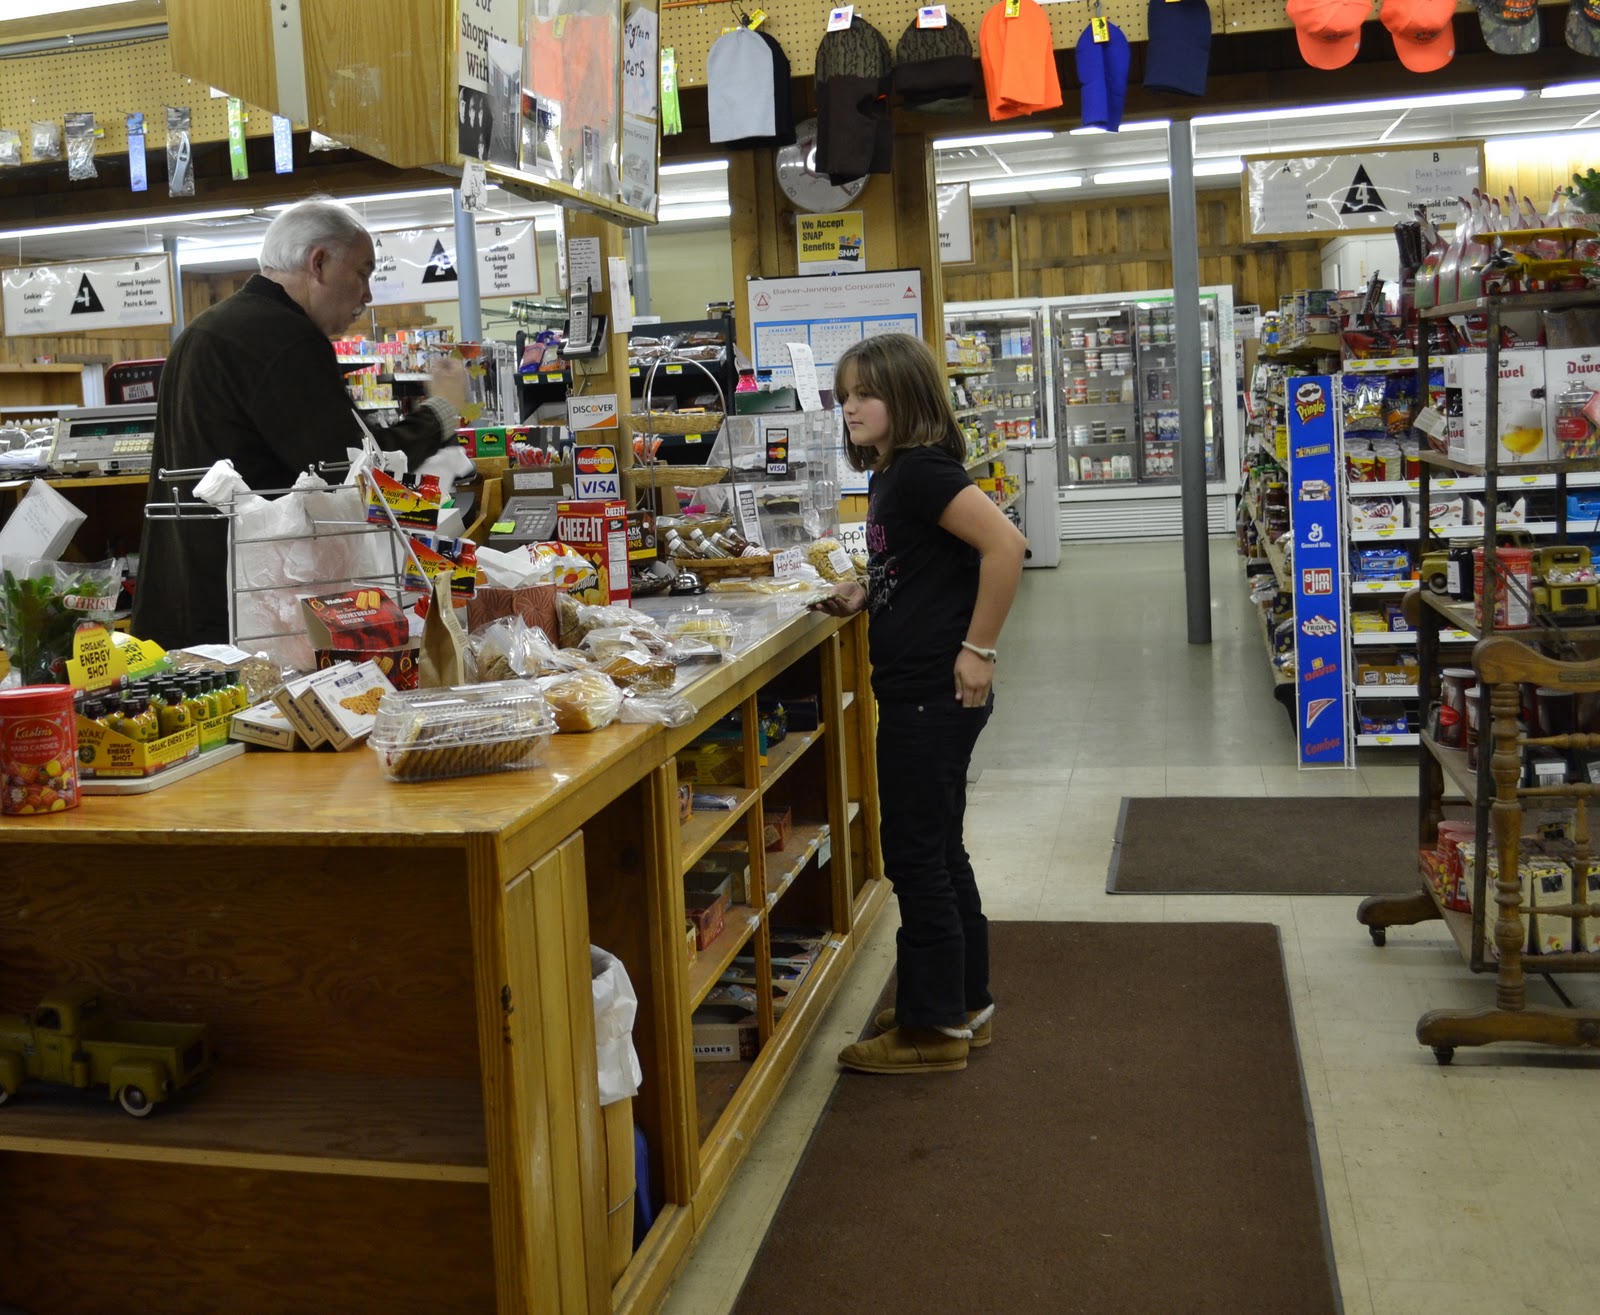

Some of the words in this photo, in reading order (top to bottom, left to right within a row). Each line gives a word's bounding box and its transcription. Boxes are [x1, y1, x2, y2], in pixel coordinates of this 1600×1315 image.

[462, 11, 507, 52] Shoppi
[624, 23, 650, 48] ergreen
[466, 51, 489, 83] With
[624, 59, 645, 77] cers
[1432, 152, 1440, 163] B
[1355, 181, 1370, 205] 4
[801, 220, 814, 230] We
[816, 218, 844, 229] Accept
[495, 227, 501, 236] B
[802, 231, 824, 241] SNAP
[375, 238, 383, 247] A
[802, 241, 836, 252] Benefits
[484, 254, 507, 263] Cooking
[507, 253, 516, 261] Oil
[838, 248, 860, 258] SNAP
[134, 262, 140, 271] B
[492, 264, 508, 272] Sugar
[116, 280, 134, 288] Canned
[134, 277, 161, 287] Vegetables
[494, 281, 511, 290] Spices
[125, 289, 139, 297] Dried
[772, 285, 843, 296] Barker-Jennings
[844, 281, 896, 292] Corporation
[1498, 364, 1525, 379] uvel
[1565, 360, 1600, 375] Duve
[572, 403, 614, 414] DISCOVER
[1296, 399, 1326, 421] Pringles
[577, 456, 615, 466] MasterCard
[769, 464, 786, 472] VISA
[581, 480, 617, 494] VISA
[604, 505, 627, 517] CHEEZ-IT
[557, 516, 604, 543] CHEEZ-IT
[627, 526, 641, 536] ARK
[838, 531, 865, 545] oppi
[628, 540, 643, 549] INIS
[325, 597, 354, 605] Walkers
[336, 609, 378, 620] SHORTBREAD
[80, 639, 107, 653] ORGANIC
[79, 648, 111, 667] ENERGY
[87, 663, 109, 680] SHOT
[202, 719, 222, 731] ORGANIC
[222, 714, 233, 726] ENE
[147, 740, 167, 754] ORGANIC
[167, 734, 185, 749] ENERGY
[184, 728, 198, 743] SHOT
[106, 748, 135, 756] ENERGY
[111, 754, 132, 762] SHOT
